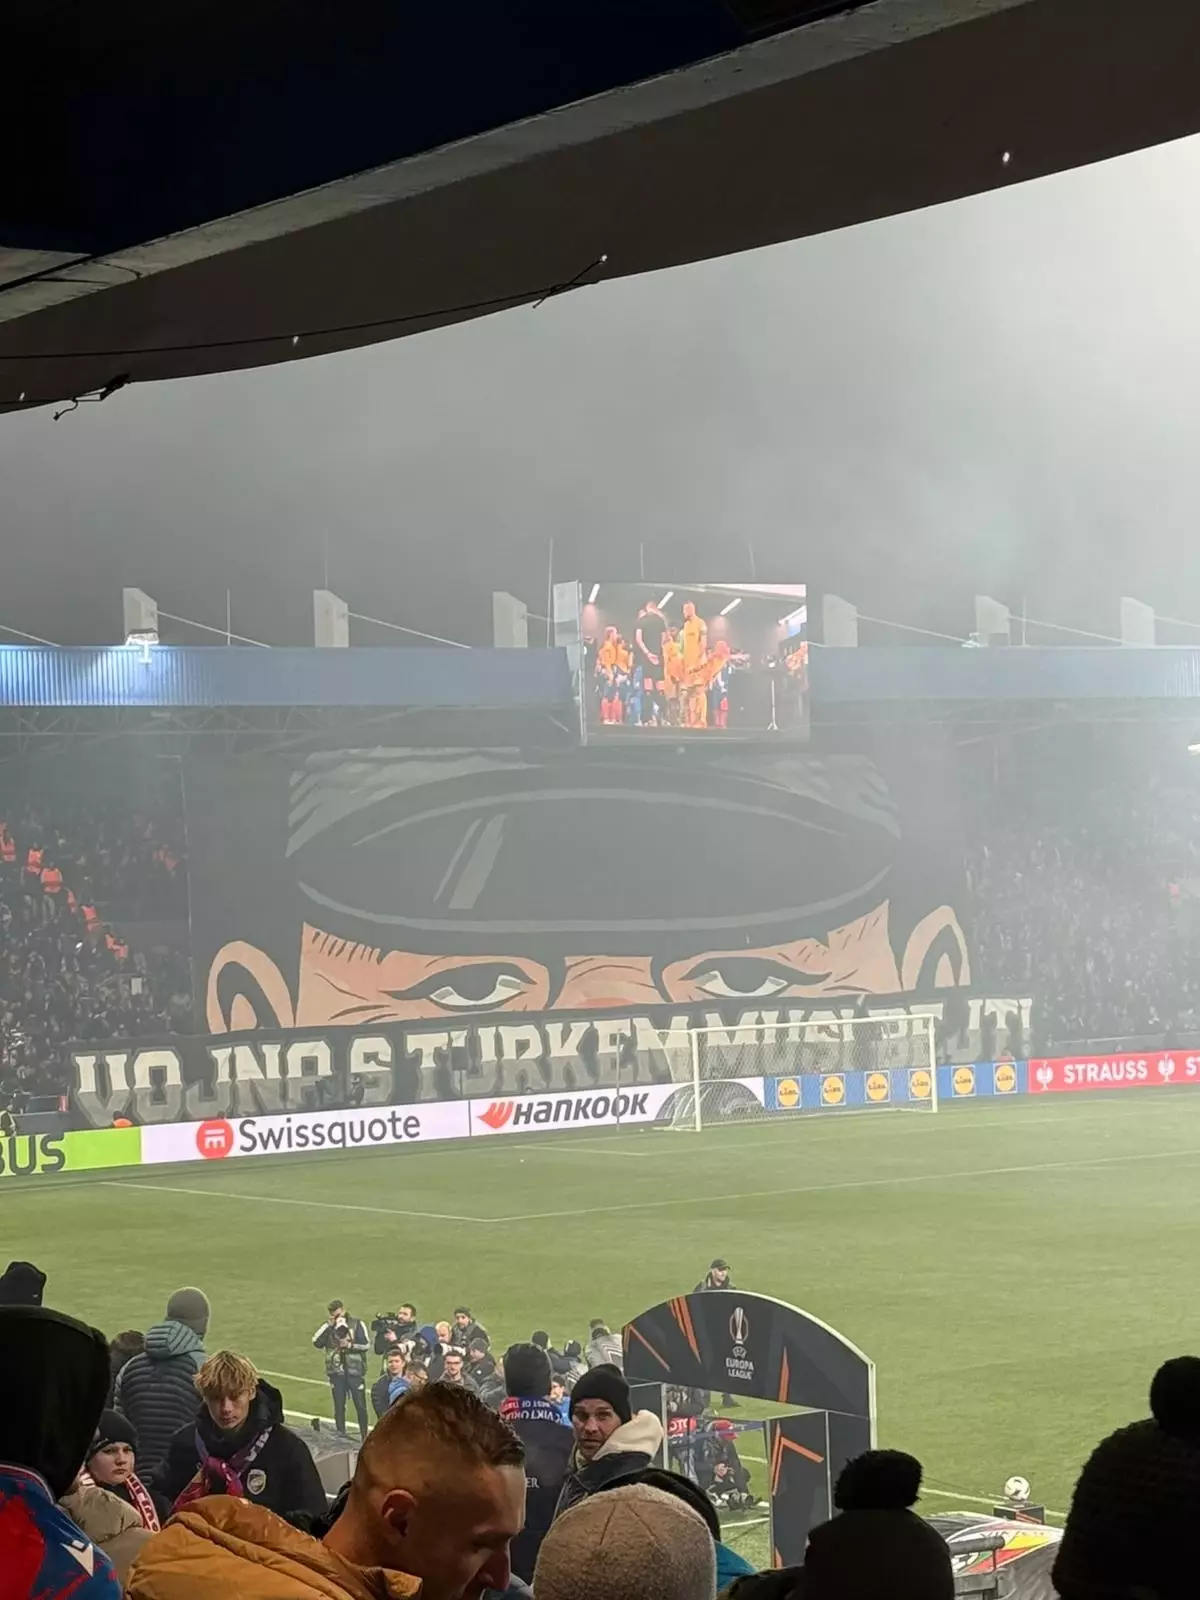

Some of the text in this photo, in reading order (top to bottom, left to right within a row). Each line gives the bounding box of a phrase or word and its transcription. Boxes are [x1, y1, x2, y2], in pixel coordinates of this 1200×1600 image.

[350, 1036, 393, 1103] S
[406, 1014, 691, 1100] TURKEM
[1063, 1060, 1148, 1084] STRAUSS
[239, 1110, 421, 1152] Swissquote
[0, 1133, 66, 1176] US
[726, 1357, 754, 1371] EUROPA
[728, 1368, 752, 1380] LEAGUE
